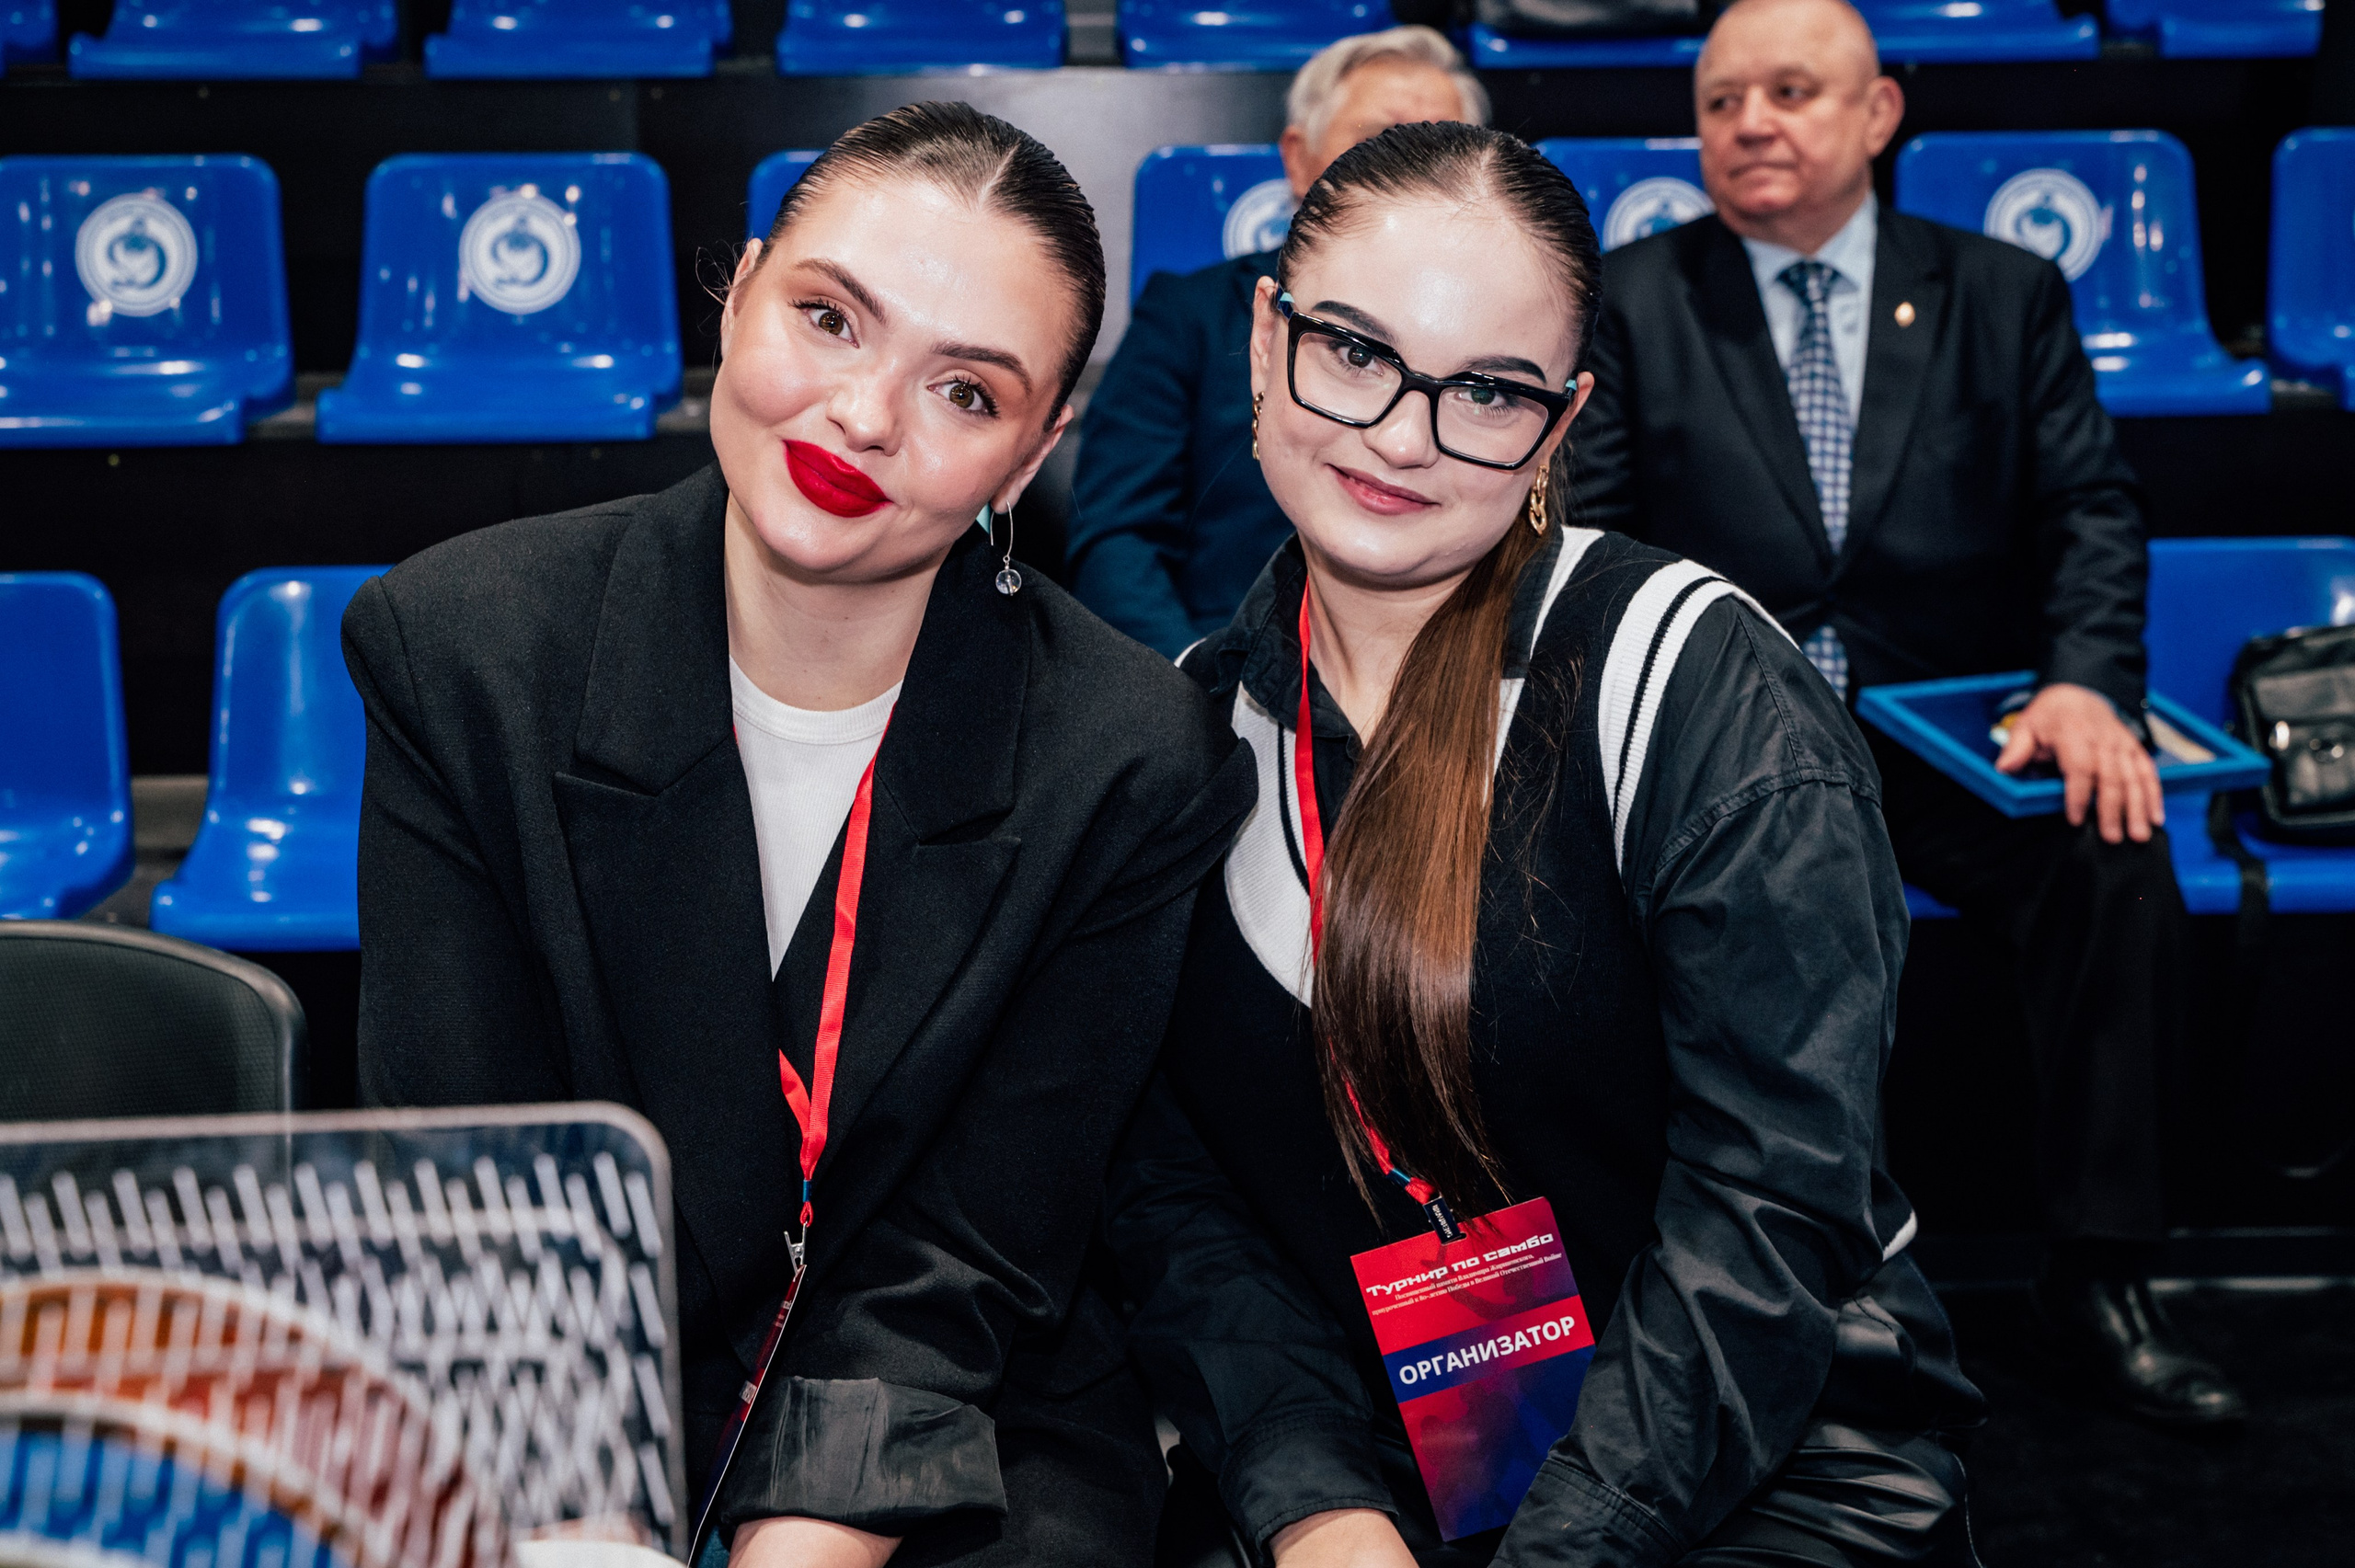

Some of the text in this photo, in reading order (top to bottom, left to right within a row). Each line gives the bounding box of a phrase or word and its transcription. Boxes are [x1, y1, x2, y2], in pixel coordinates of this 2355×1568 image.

[1432, 1204, 1453, 1238] BRAUBERG
[1366, 1233, 1554, 1297] Турнир по самбо
[1398, 1316, 1576, 1385] ОРГАНИЗАТОР
